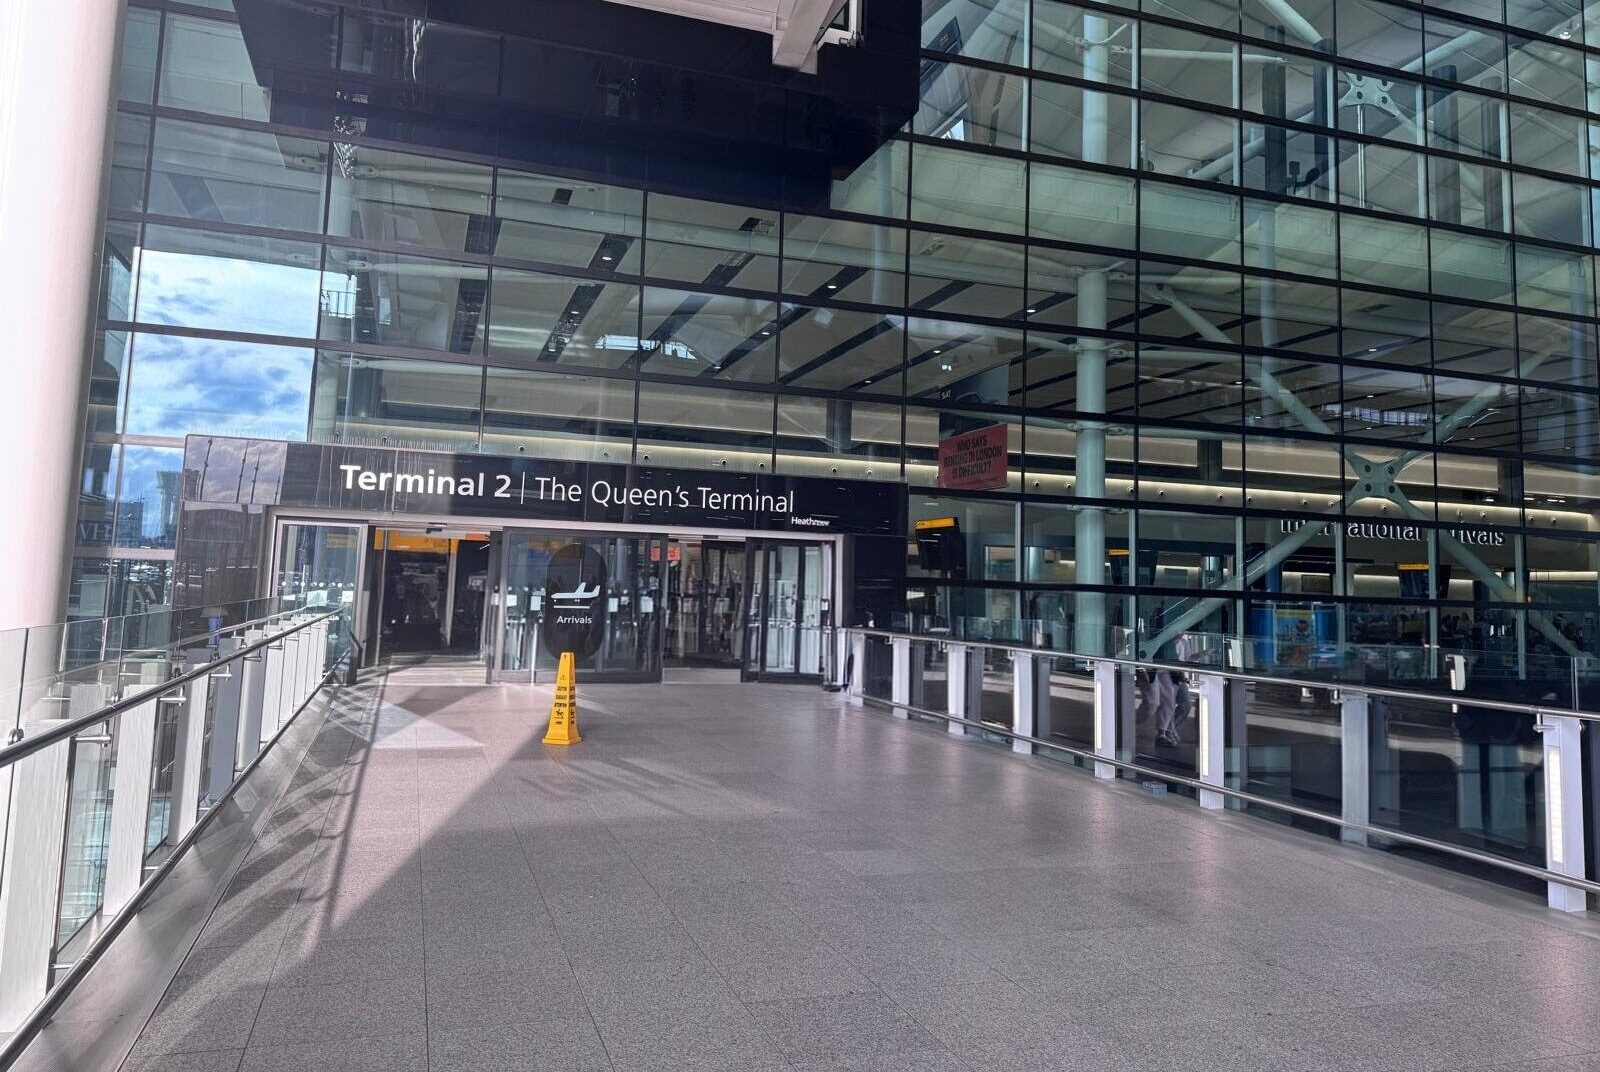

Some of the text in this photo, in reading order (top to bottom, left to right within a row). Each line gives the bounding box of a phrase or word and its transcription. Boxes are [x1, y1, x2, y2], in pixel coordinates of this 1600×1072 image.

[971, 435, 987, 447] SAYS
[968, 450, 975, 463] IN
[976, 446, 1002, 461] LONDON
[339, 464, 794, 513] Terminal 2 The Queen's Terminal
[556, 615, 592, 624] Arrivals
